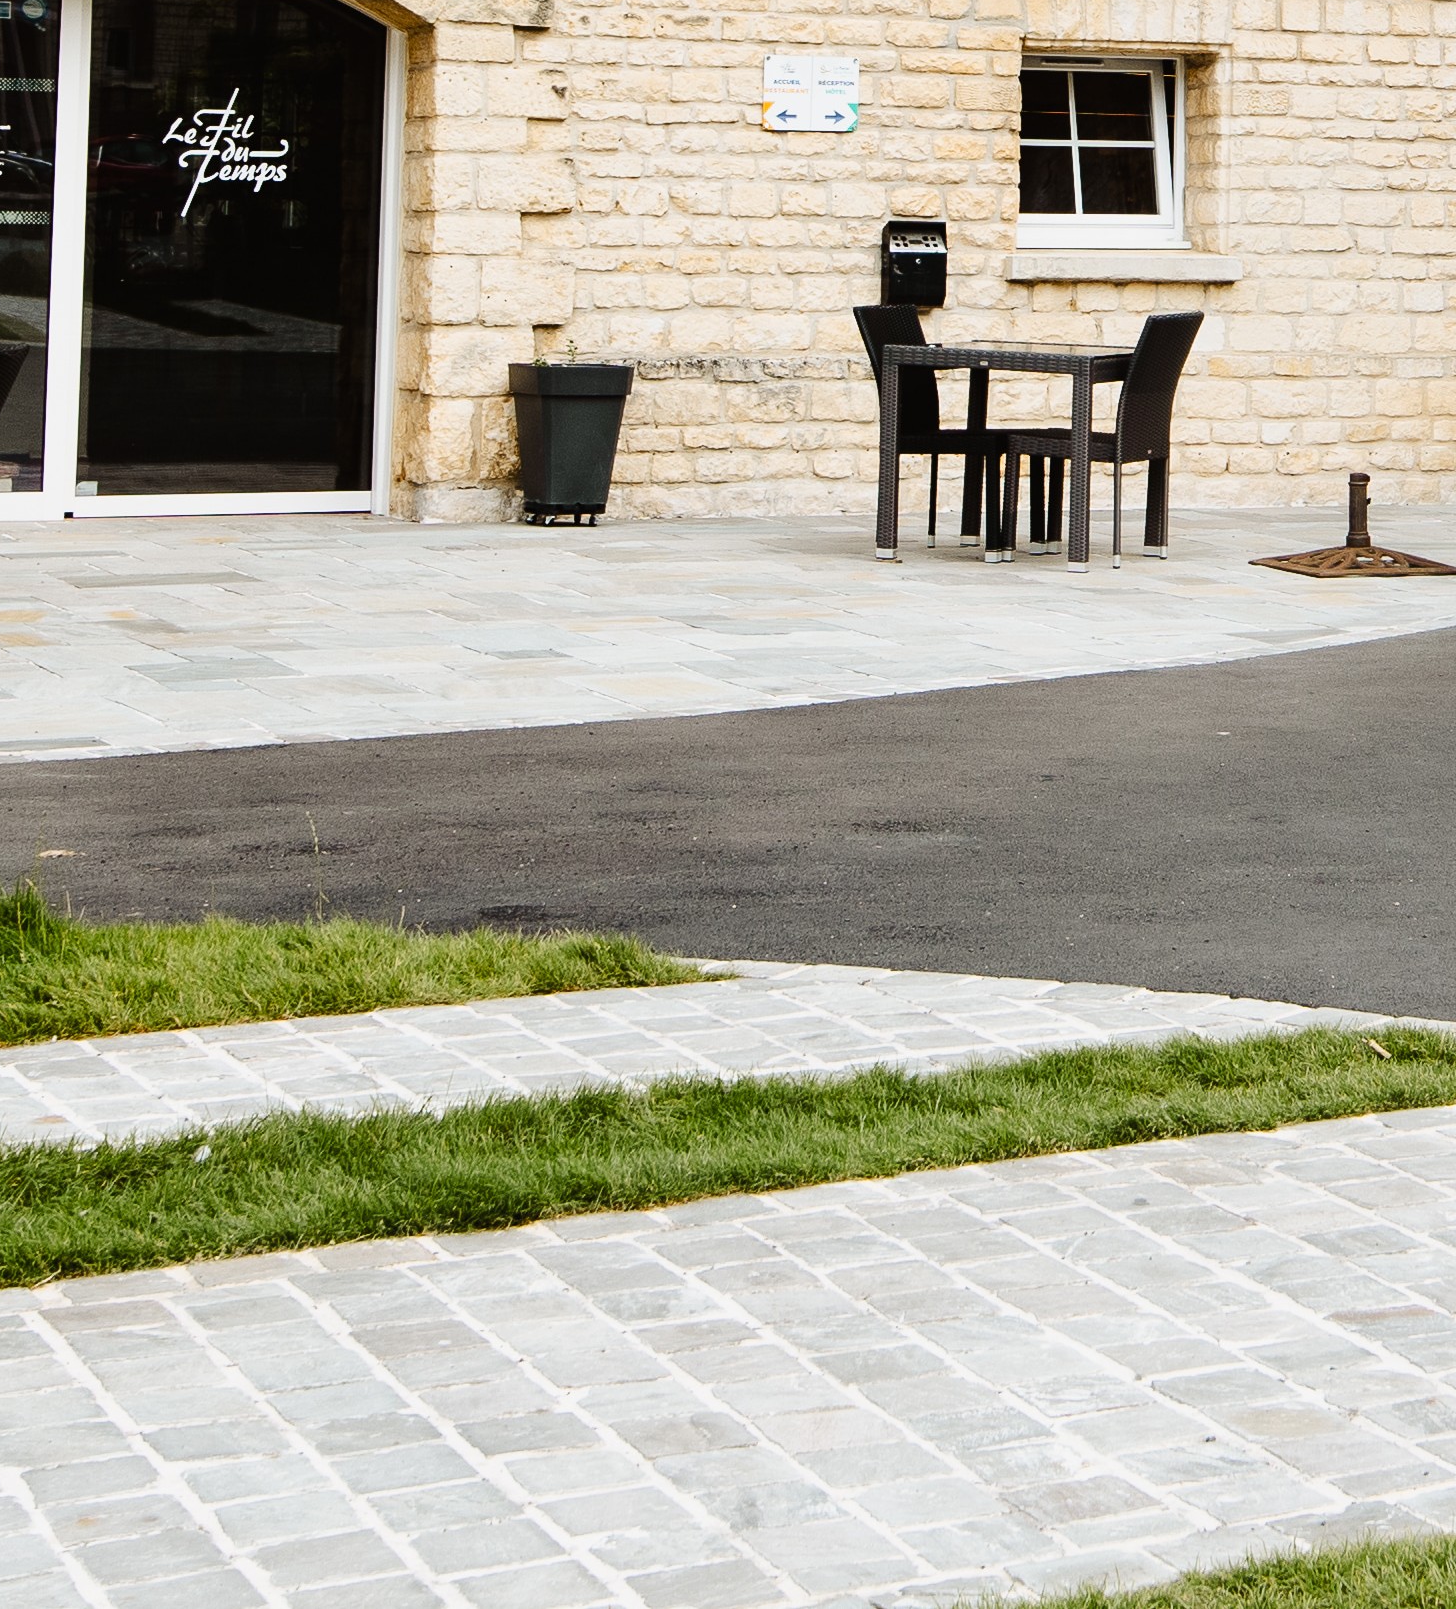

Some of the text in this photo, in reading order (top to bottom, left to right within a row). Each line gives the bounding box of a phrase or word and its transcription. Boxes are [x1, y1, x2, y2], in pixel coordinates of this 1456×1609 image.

[162, 109, 255, 147] Le Fil
[178, 150, 287, 192] Temps
